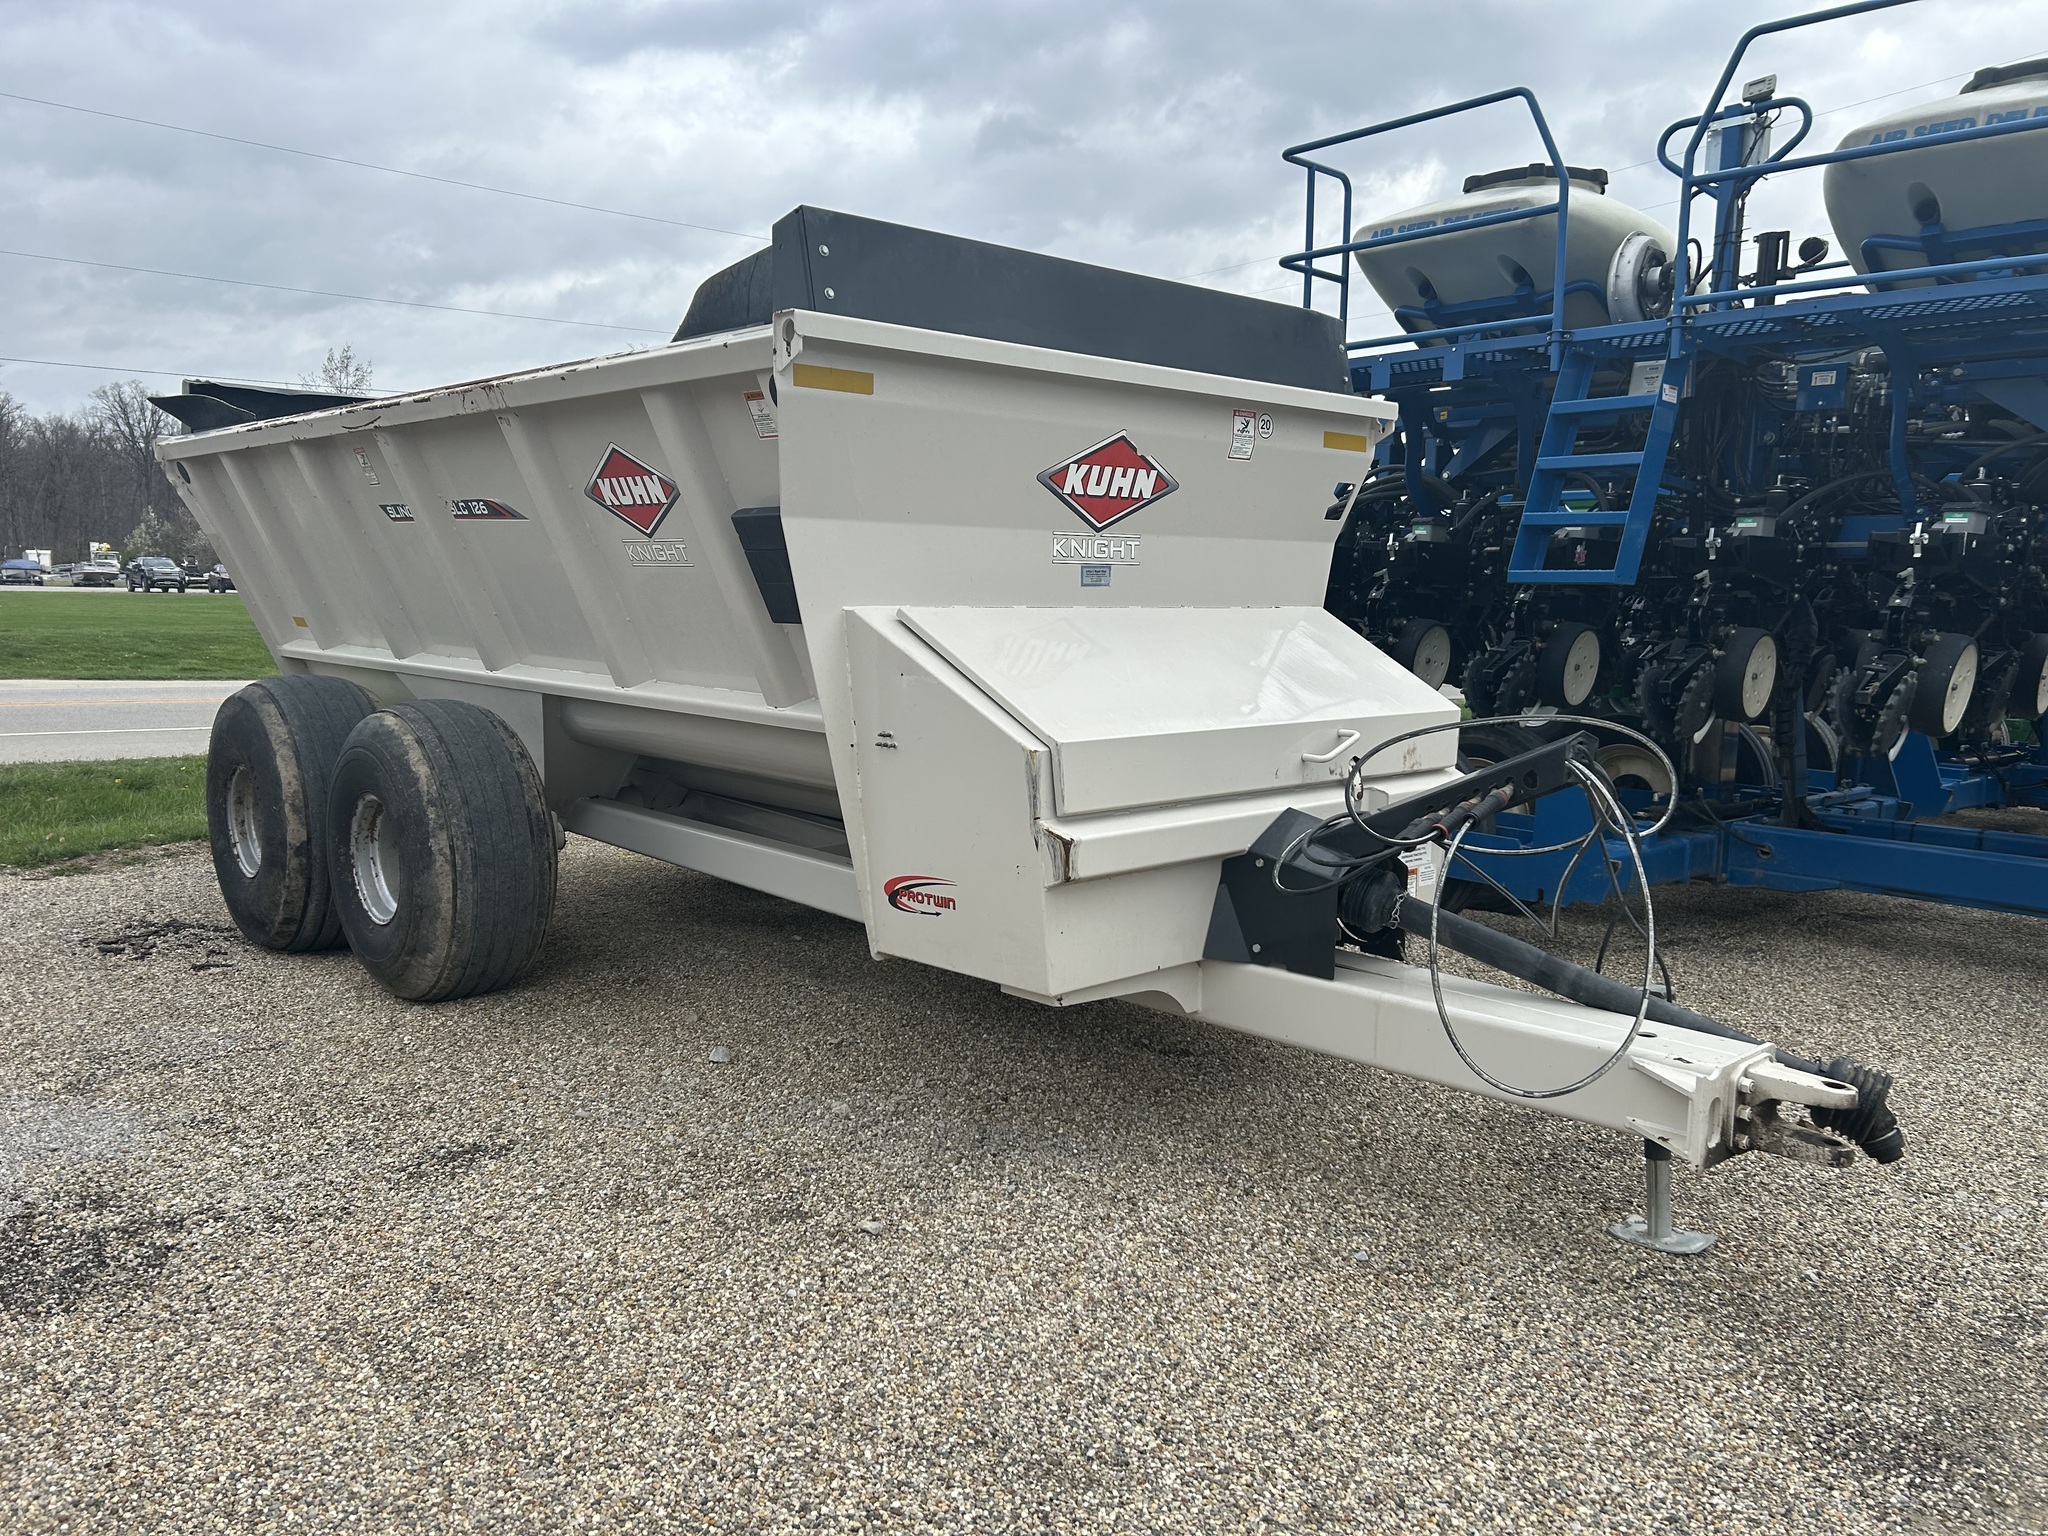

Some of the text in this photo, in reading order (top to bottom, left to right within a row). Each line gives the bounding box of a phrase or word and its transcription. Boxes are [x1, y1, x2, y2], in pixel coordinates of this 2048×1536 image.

[1260, 418, 1271, 431] 20
[596, 474, 668, 507] KUHN
[1062, 463, 1158, 499] KUHN
[468, 501, 489, 515] 126
[624, 544, 689, 562] KNIGHT
[1052, 537, 1141, 560] KNIGHT
[898, 888, 957, 911] PROTWIN
